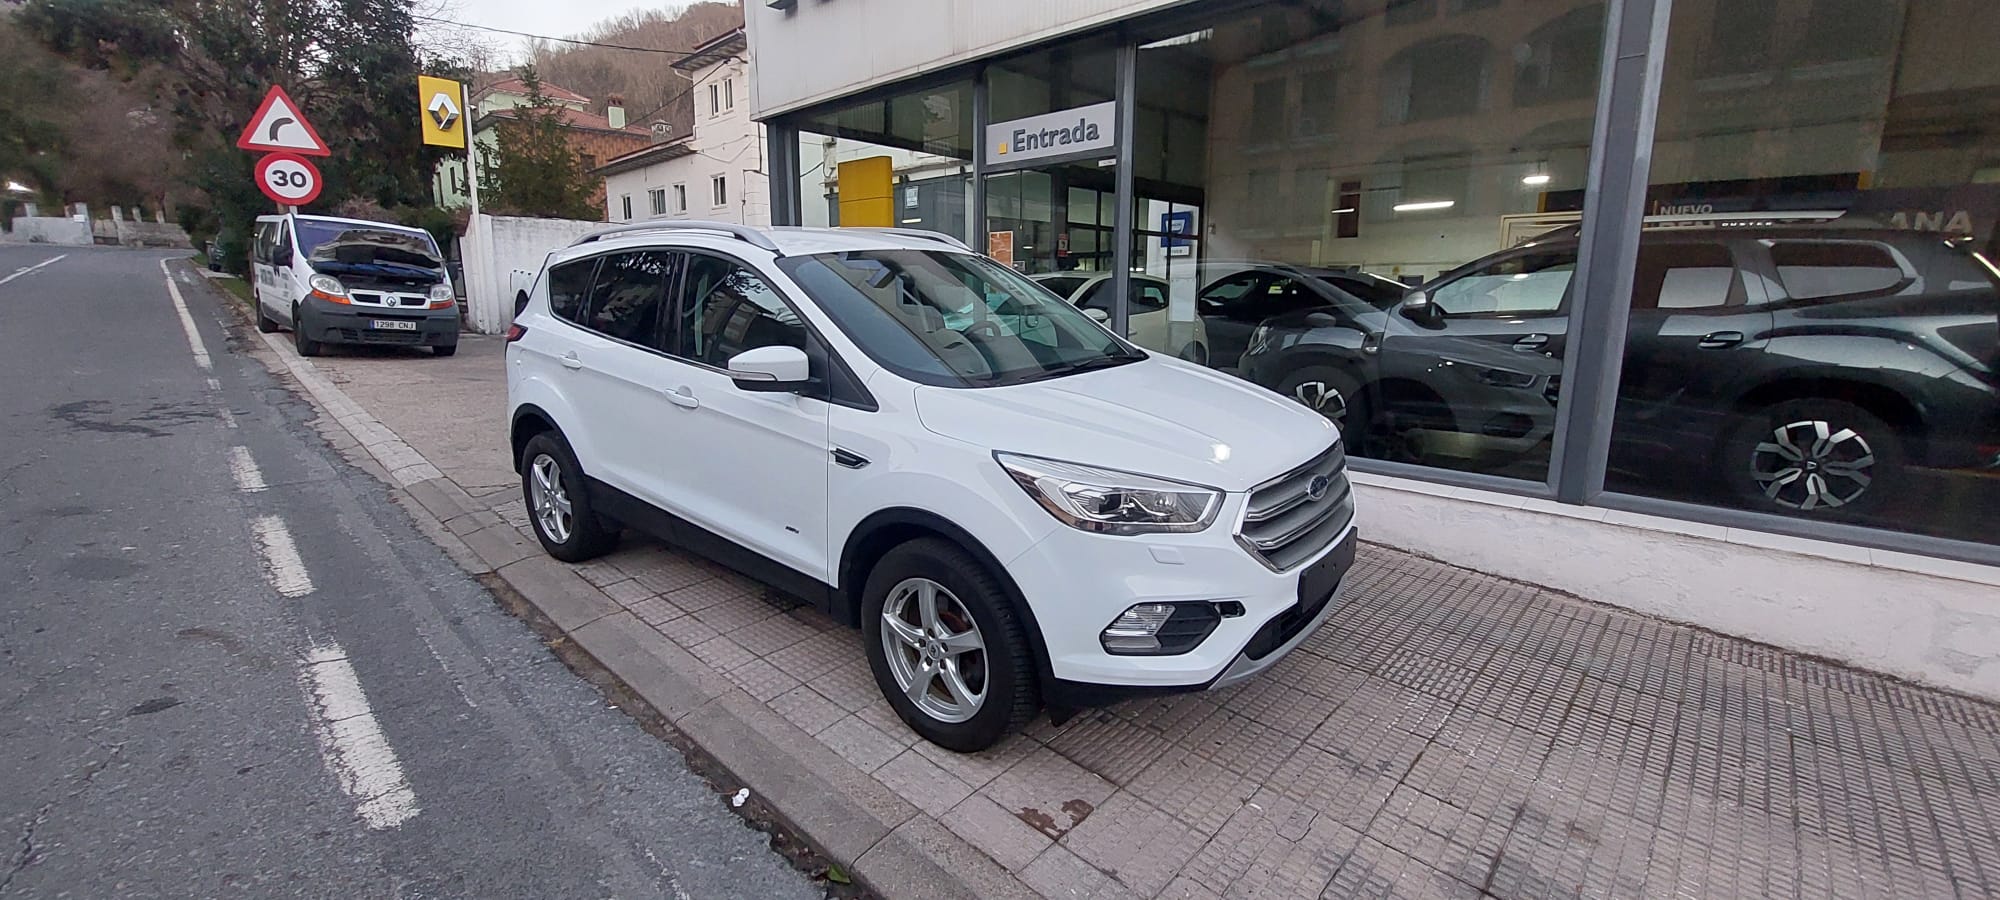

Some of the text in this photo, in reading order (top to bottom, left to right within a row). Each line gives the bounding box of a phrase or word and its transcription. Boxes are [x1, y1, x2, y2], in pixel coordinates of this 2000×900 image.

[1012, 118, 1100, 153] Entrada
[272, 169, 307, 188] 30
[1660, 204, 1713, 215] NUEVO
[375, 321, 395, 329] 1298
